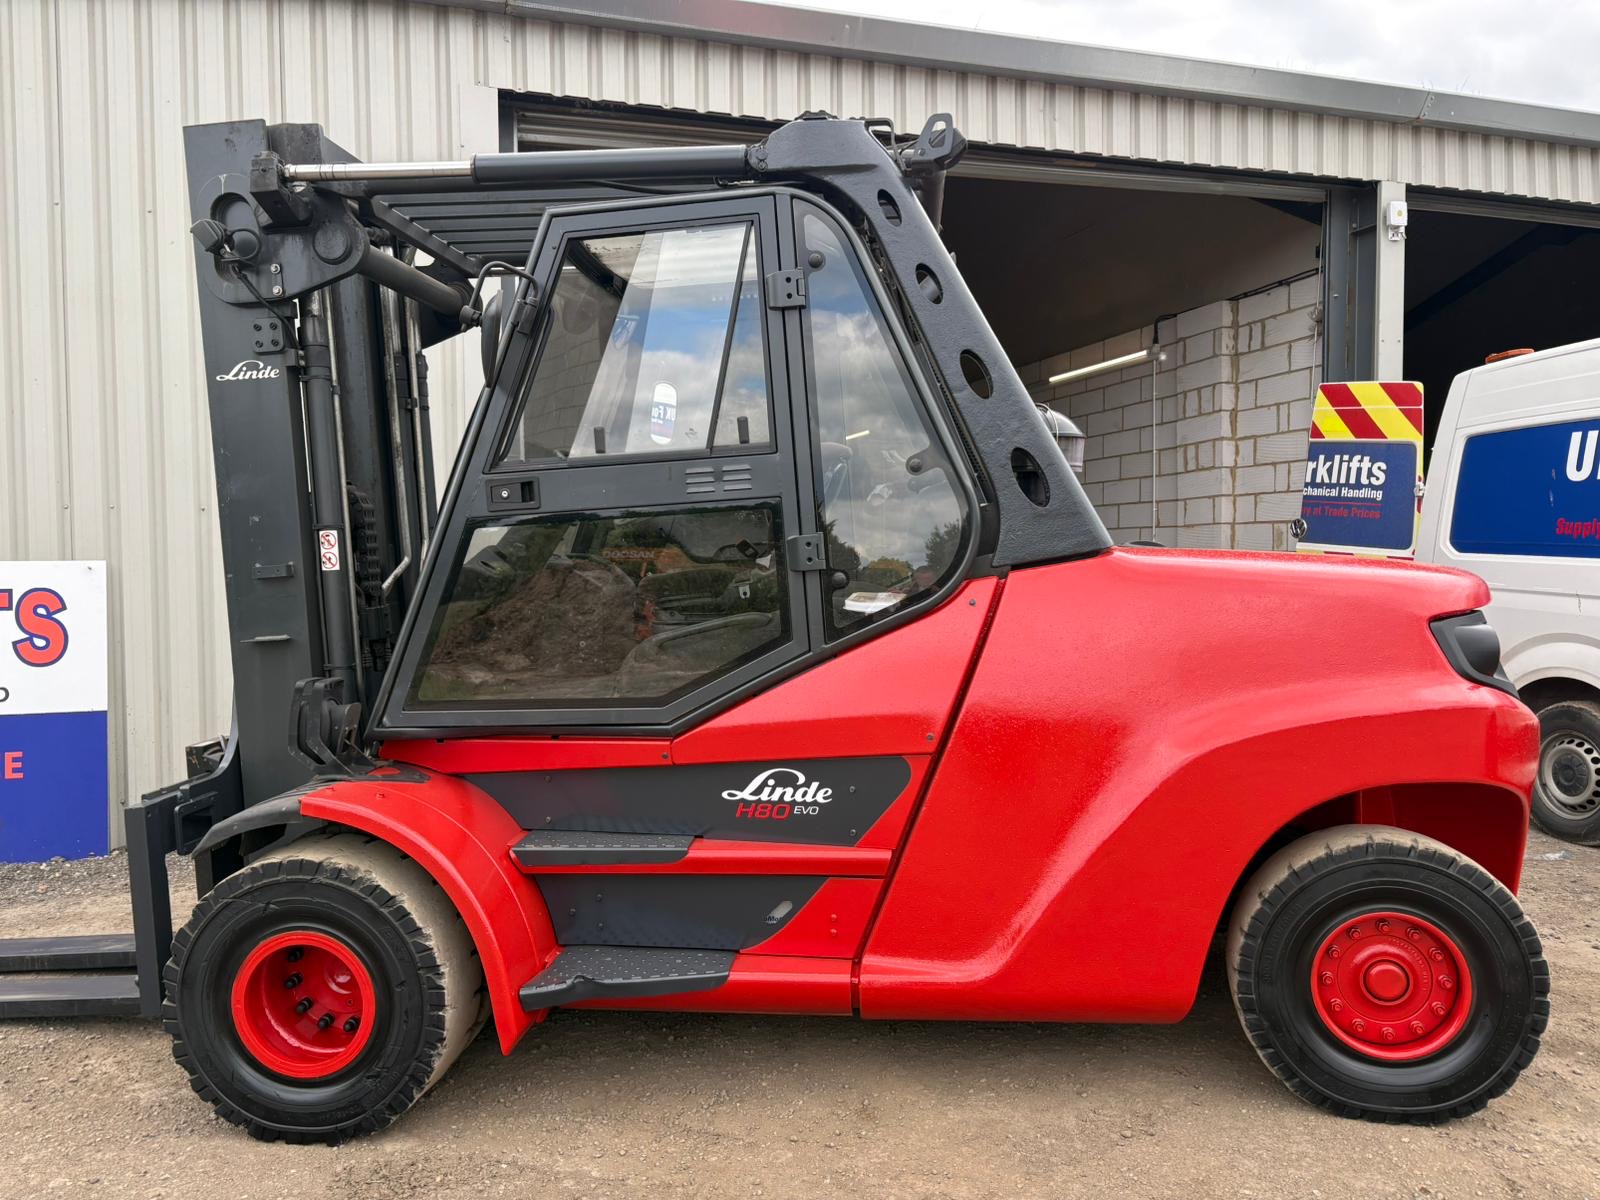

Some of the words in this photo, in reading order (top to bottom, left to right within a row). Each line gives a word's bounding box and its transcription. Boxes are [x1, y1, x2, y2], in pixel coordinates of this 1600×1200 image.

[215, 359, 280, 381] Linde
[1566, 430, 1600, 482] U
[1305, 454, 1387, 486] rklifts
[1341, 487, 1383, 501] Handling
[1325, 506, 1348, 518] Trade
[1351, 507, 1382, 520] Prices
[721, 768, 832, 803] Linde
[736, 803, 791, 819] H80
[793, 805, 819, 815] EVO
